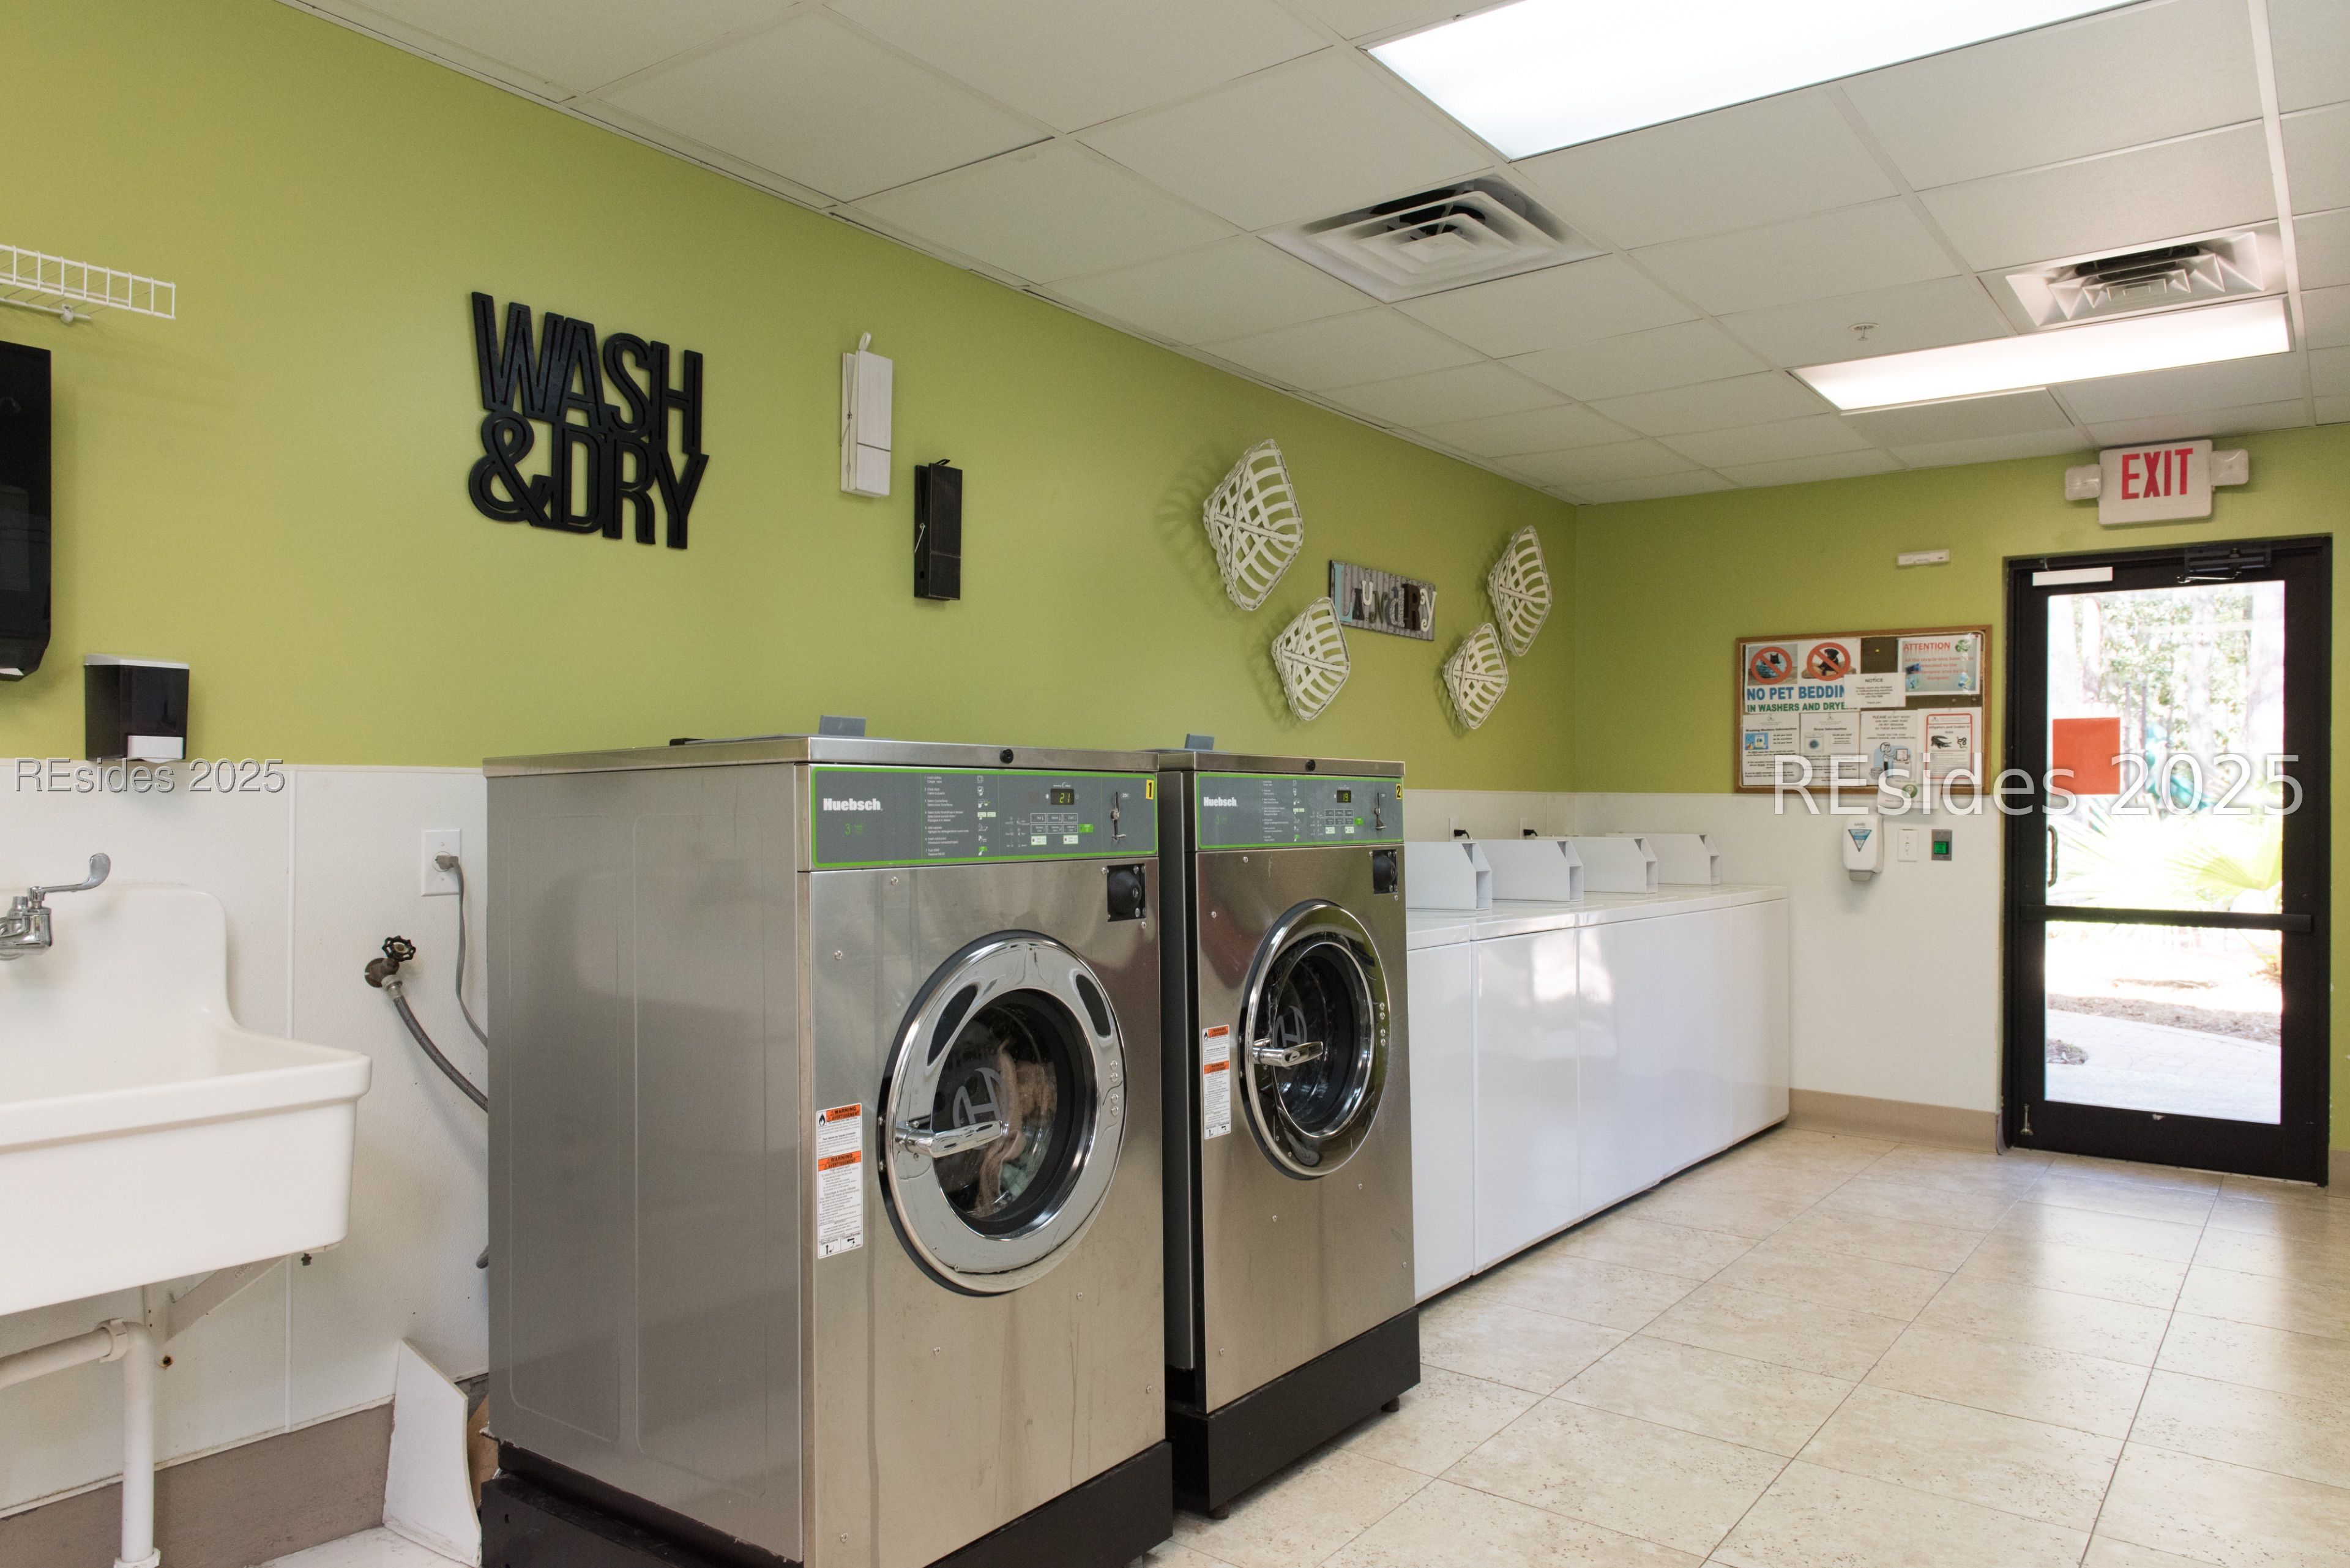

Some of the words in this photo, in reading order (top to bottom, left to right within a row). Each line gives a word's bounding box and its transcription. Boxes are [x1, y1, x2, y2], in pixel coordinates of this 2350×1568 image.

[472, 291, 703, 455] WASH
[2122, 448, 2193, 499] EXIT
[1903, 642, 1950, 651] ATTENTION
[1747, 688, 1765, 700] NO
[1769, 687, 1794, 700] PET
[1799, 685, 1845, 699] BEDDIN
[1757, 703, 1799, 712] WASHERS
[1148, 782, 1152, 798] 1
[1397, 785, 1401, 798] 2
[1059, 793, 1070, 803] 21
[1204, 797, 1237, 807] Huebsch
[823, 798, 881, 811] Huebsch
[832, 1111, 859, 1121] AVERTISSEMENT
[828, 1158, 856, 1168] AVERTISSEMENT
[830, 1154, 852, 1162] WARNING
